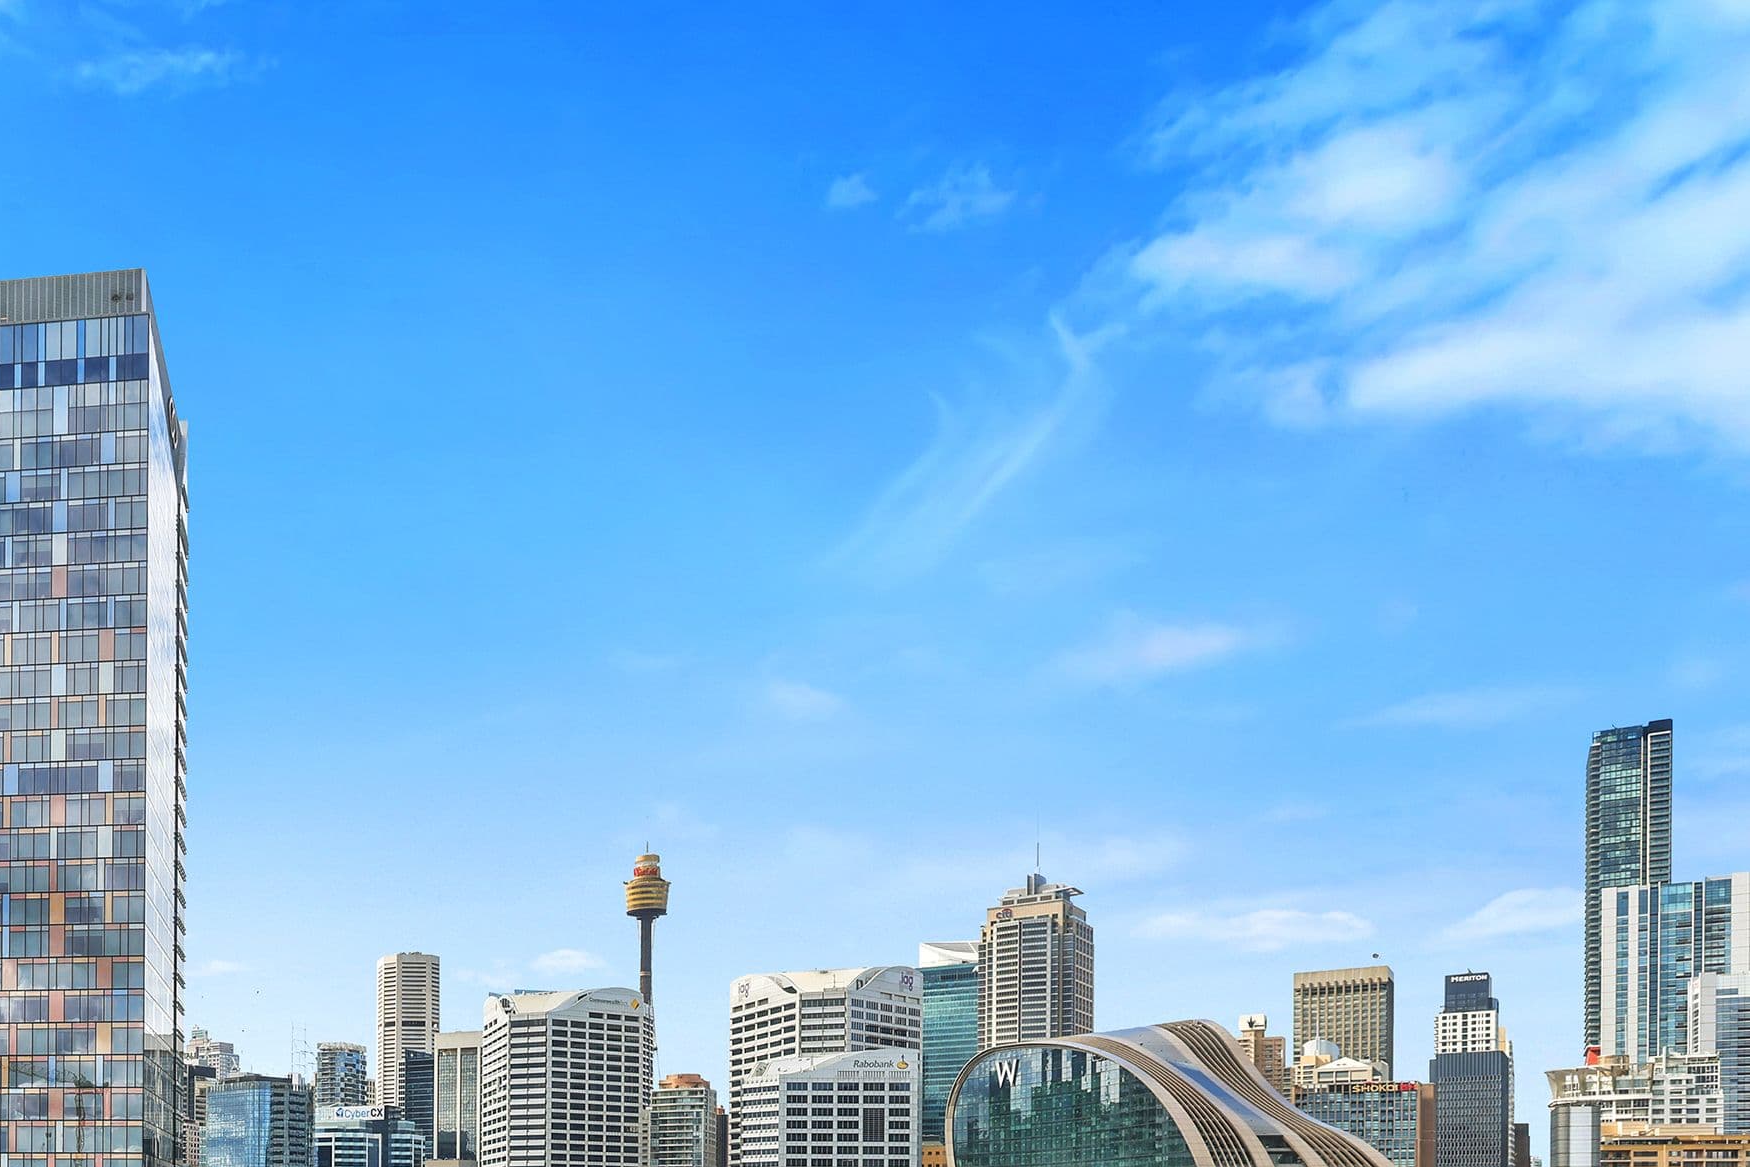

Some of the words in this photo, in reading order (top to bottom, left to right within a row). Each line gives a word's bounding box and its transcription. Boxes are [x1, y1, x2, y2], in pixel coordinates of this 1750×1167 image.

[1450, 974, 1487, 983] MERITON
[853, 1059, 895, 1069] Rabobank
[994, 1058, 1020, 1089] W
[344, 1107, 384, 1120] CyberCX
